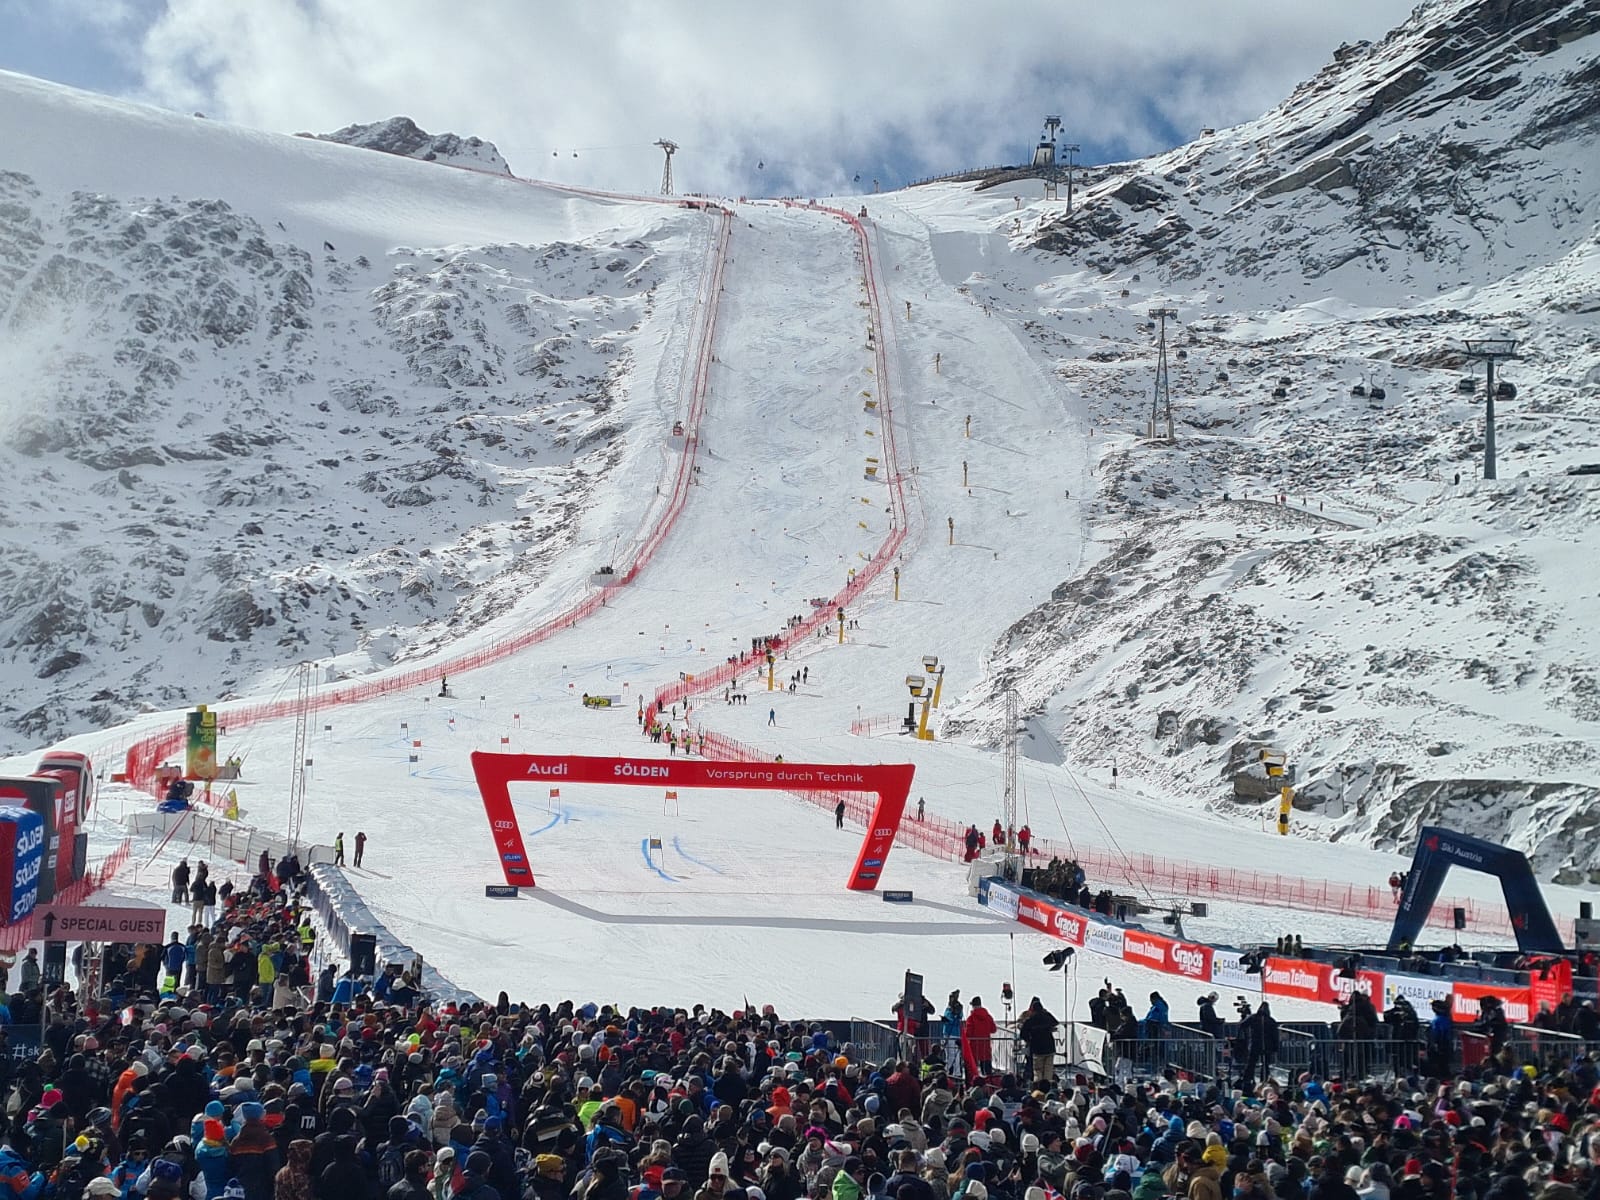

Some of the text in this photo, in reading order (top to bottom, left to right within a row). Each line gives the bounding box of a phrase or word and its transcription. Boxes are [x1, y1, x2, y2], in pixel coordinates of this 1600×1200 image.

[527, 762, 568, 775] Audi
[614, 763, 669, 777] SÖLDEN
[706, 768, 864, 783] Vorsprung durch Technik
[1440, 842, 1483, 863] Ski Austria
[60, 918, 162, 933] SPECIAL GUEST
[1290, 968, 1318, 992] Zeitung
[1397, 985, 1445, 1000] CASABLANC
[12, 1043, 42, 1060] #sk
[301, 1115, 316, 1129] ITA
